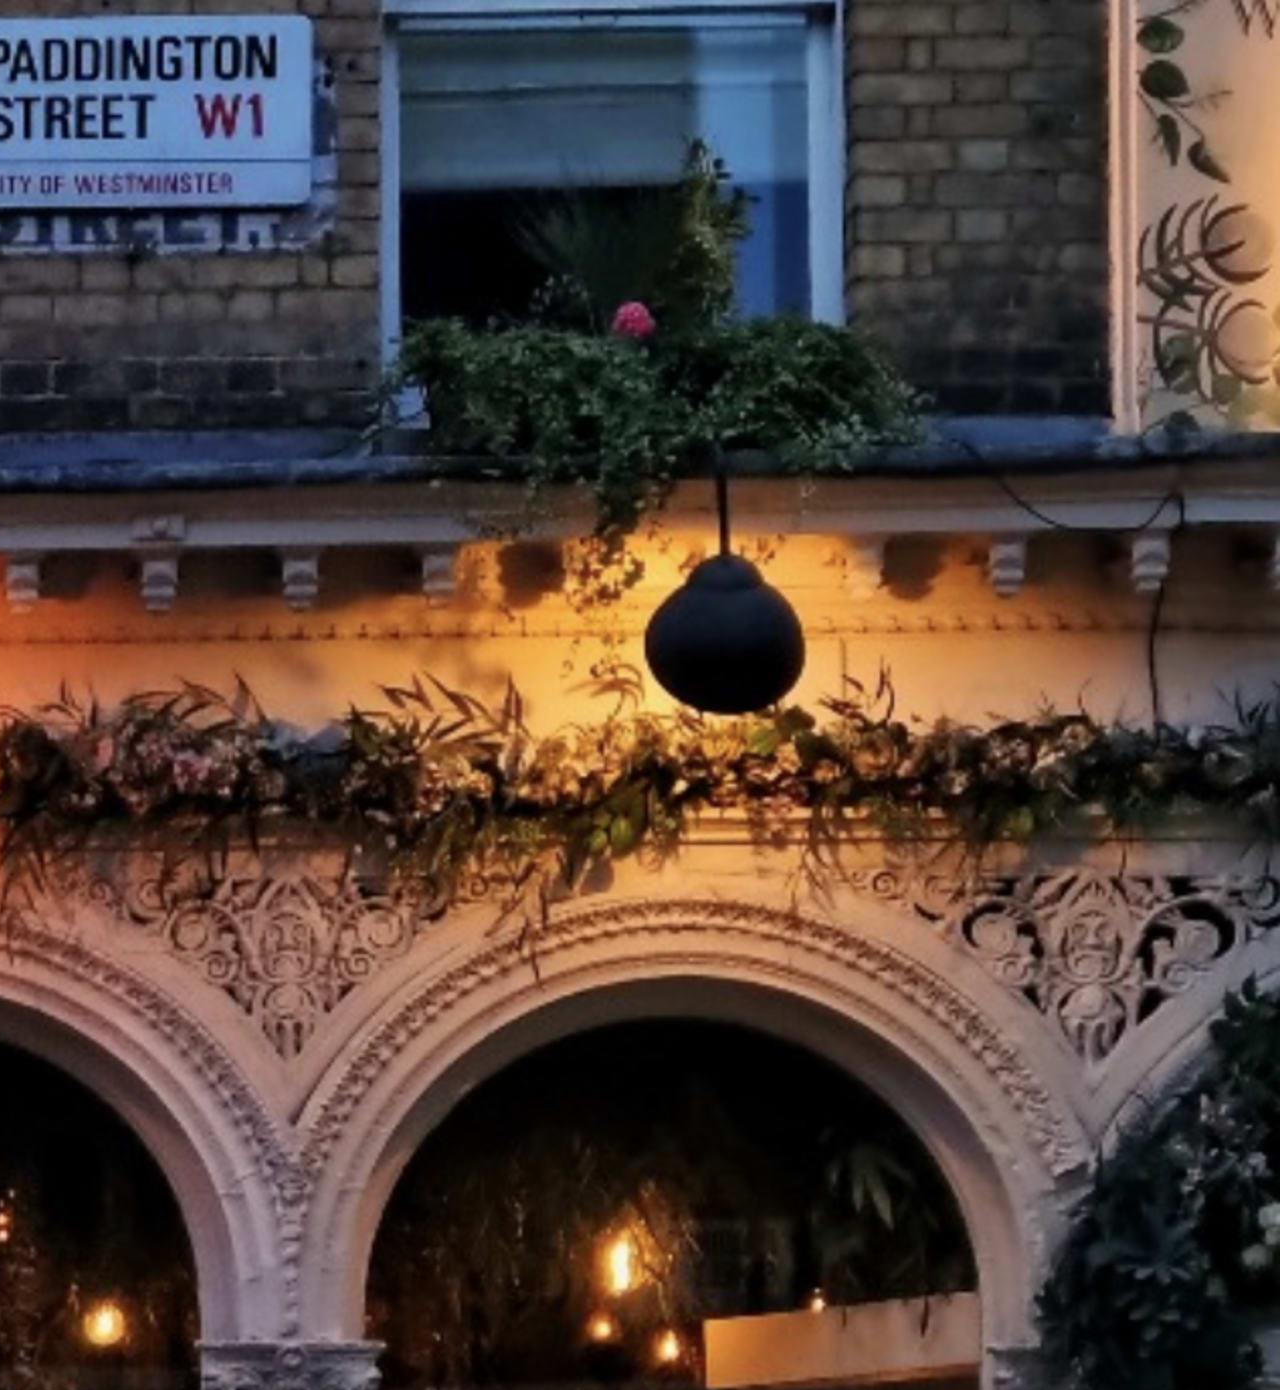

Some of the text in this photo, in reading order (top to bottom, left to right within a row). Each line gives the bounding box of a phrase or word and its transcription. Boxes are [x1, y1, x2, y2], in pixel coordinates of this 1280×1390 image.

[194, 93, 265, 138] W1
[40, 174, 66, 195] OF
[76, 172, 234, 195] WESTMINSTER
